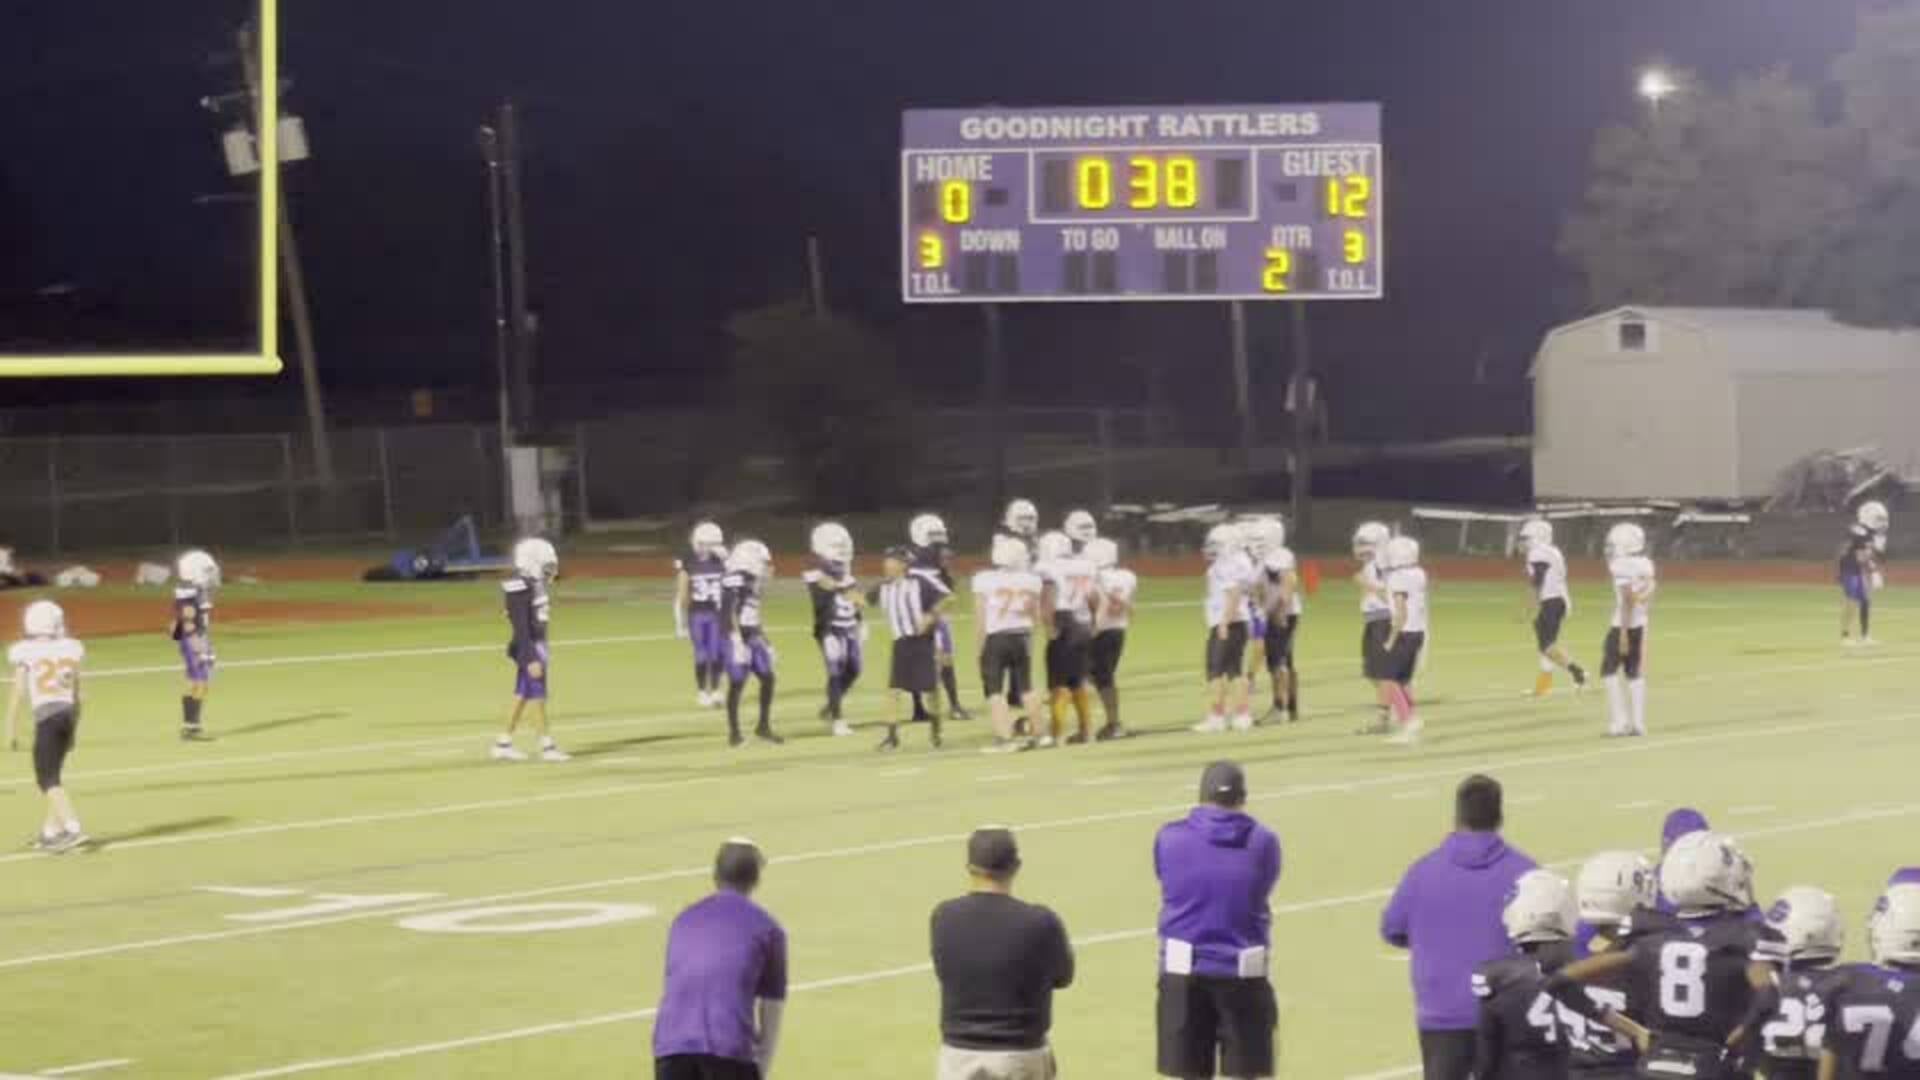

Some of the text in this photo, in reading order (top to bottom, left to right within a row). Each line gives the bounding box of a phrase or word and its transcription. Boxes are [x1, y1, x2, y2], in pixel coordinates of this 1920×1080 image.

[960, 112, 1320, 139] GOODNIGHT RATTLERS
[916, 155, 993, 181] HOME
[1283, 149, 1372, 177] GUEST
[1078, 156, 1197, 209] 0 38
[1327, 174, 1373, 218] 12
[942, 180, 971, 223] 0
[918, 231, 944, 268] 3
[960, 229, 1021, 252] DOWN
[1061, 227, 1119, 251] TO GO
[1154, 225, 1228, 249] BALL ON
[1343, 228, 1366, 264] 3
[1262, 246, 1292, 292] 2
[1659, 941, 1708, 1018] 8
